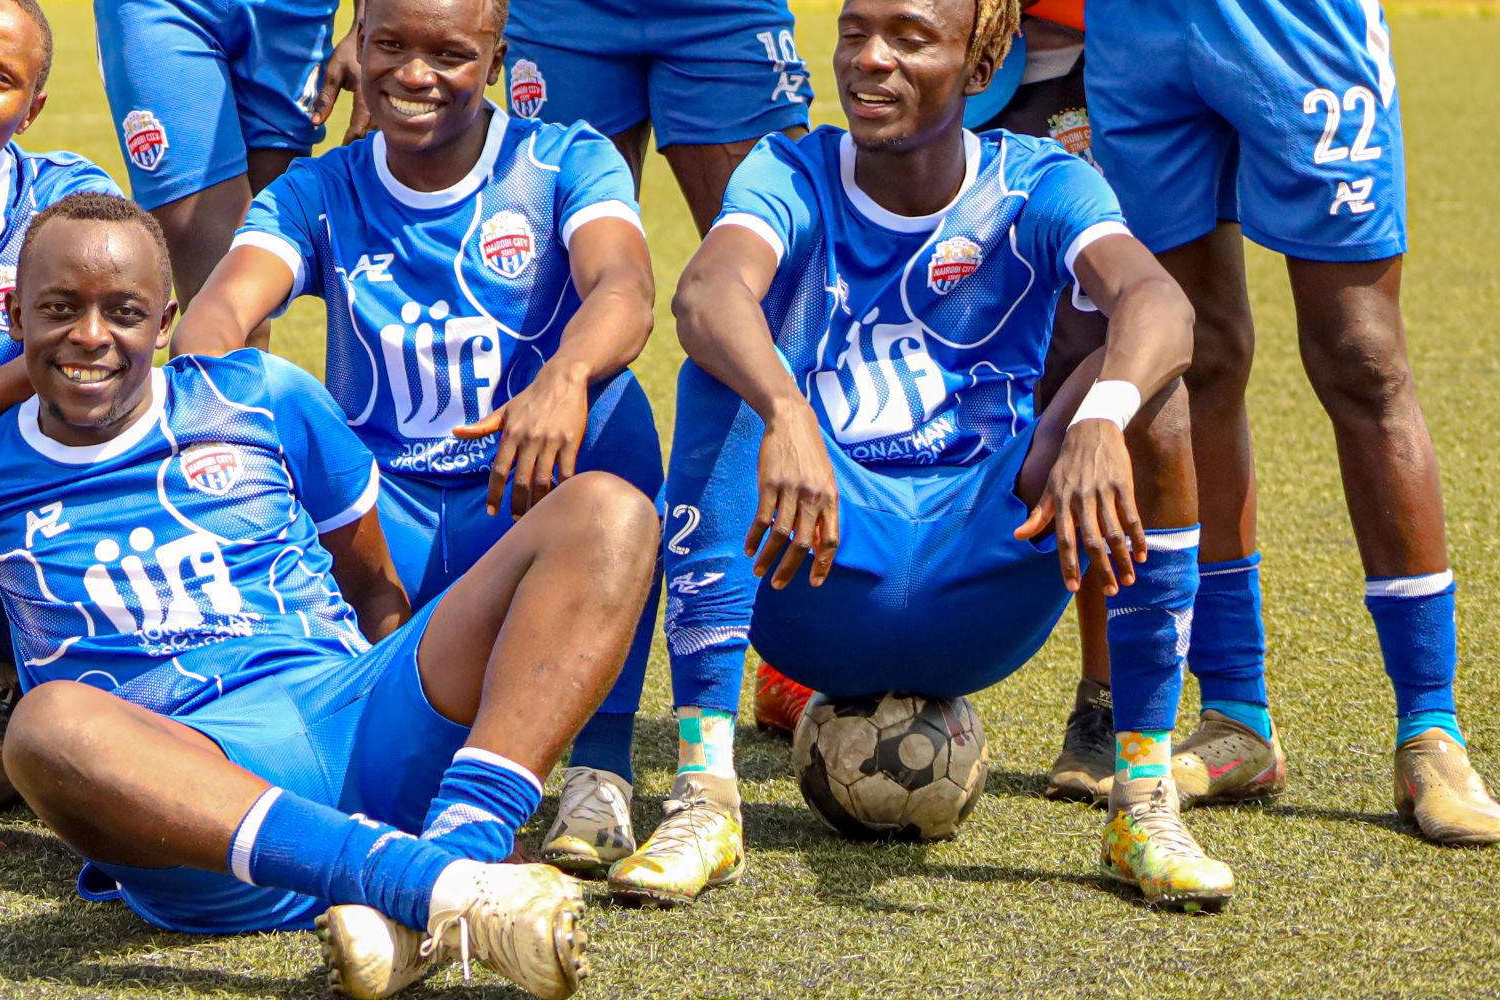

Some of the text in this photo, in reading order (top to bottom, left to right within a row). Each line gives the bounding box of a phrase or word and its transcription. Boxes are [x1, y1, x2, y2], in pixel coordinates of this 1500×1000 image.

[756, 29, 806, 73] 10
[771, 72, 804, 103] AZ
[1061, 129, 1082, 146] IROBI
[1303, 85, 1381, 165] 22
[1330, 177, 1375, 215] AZ
[485, 238, 529, 254] NAIROBI CITY
[347, 253, 394, 282] AZ
[933, 265, 975, 277] NAIROBI CITY
[390, 450, 485, 473] JACKSON
[25, 500, 70, 549] AZ
